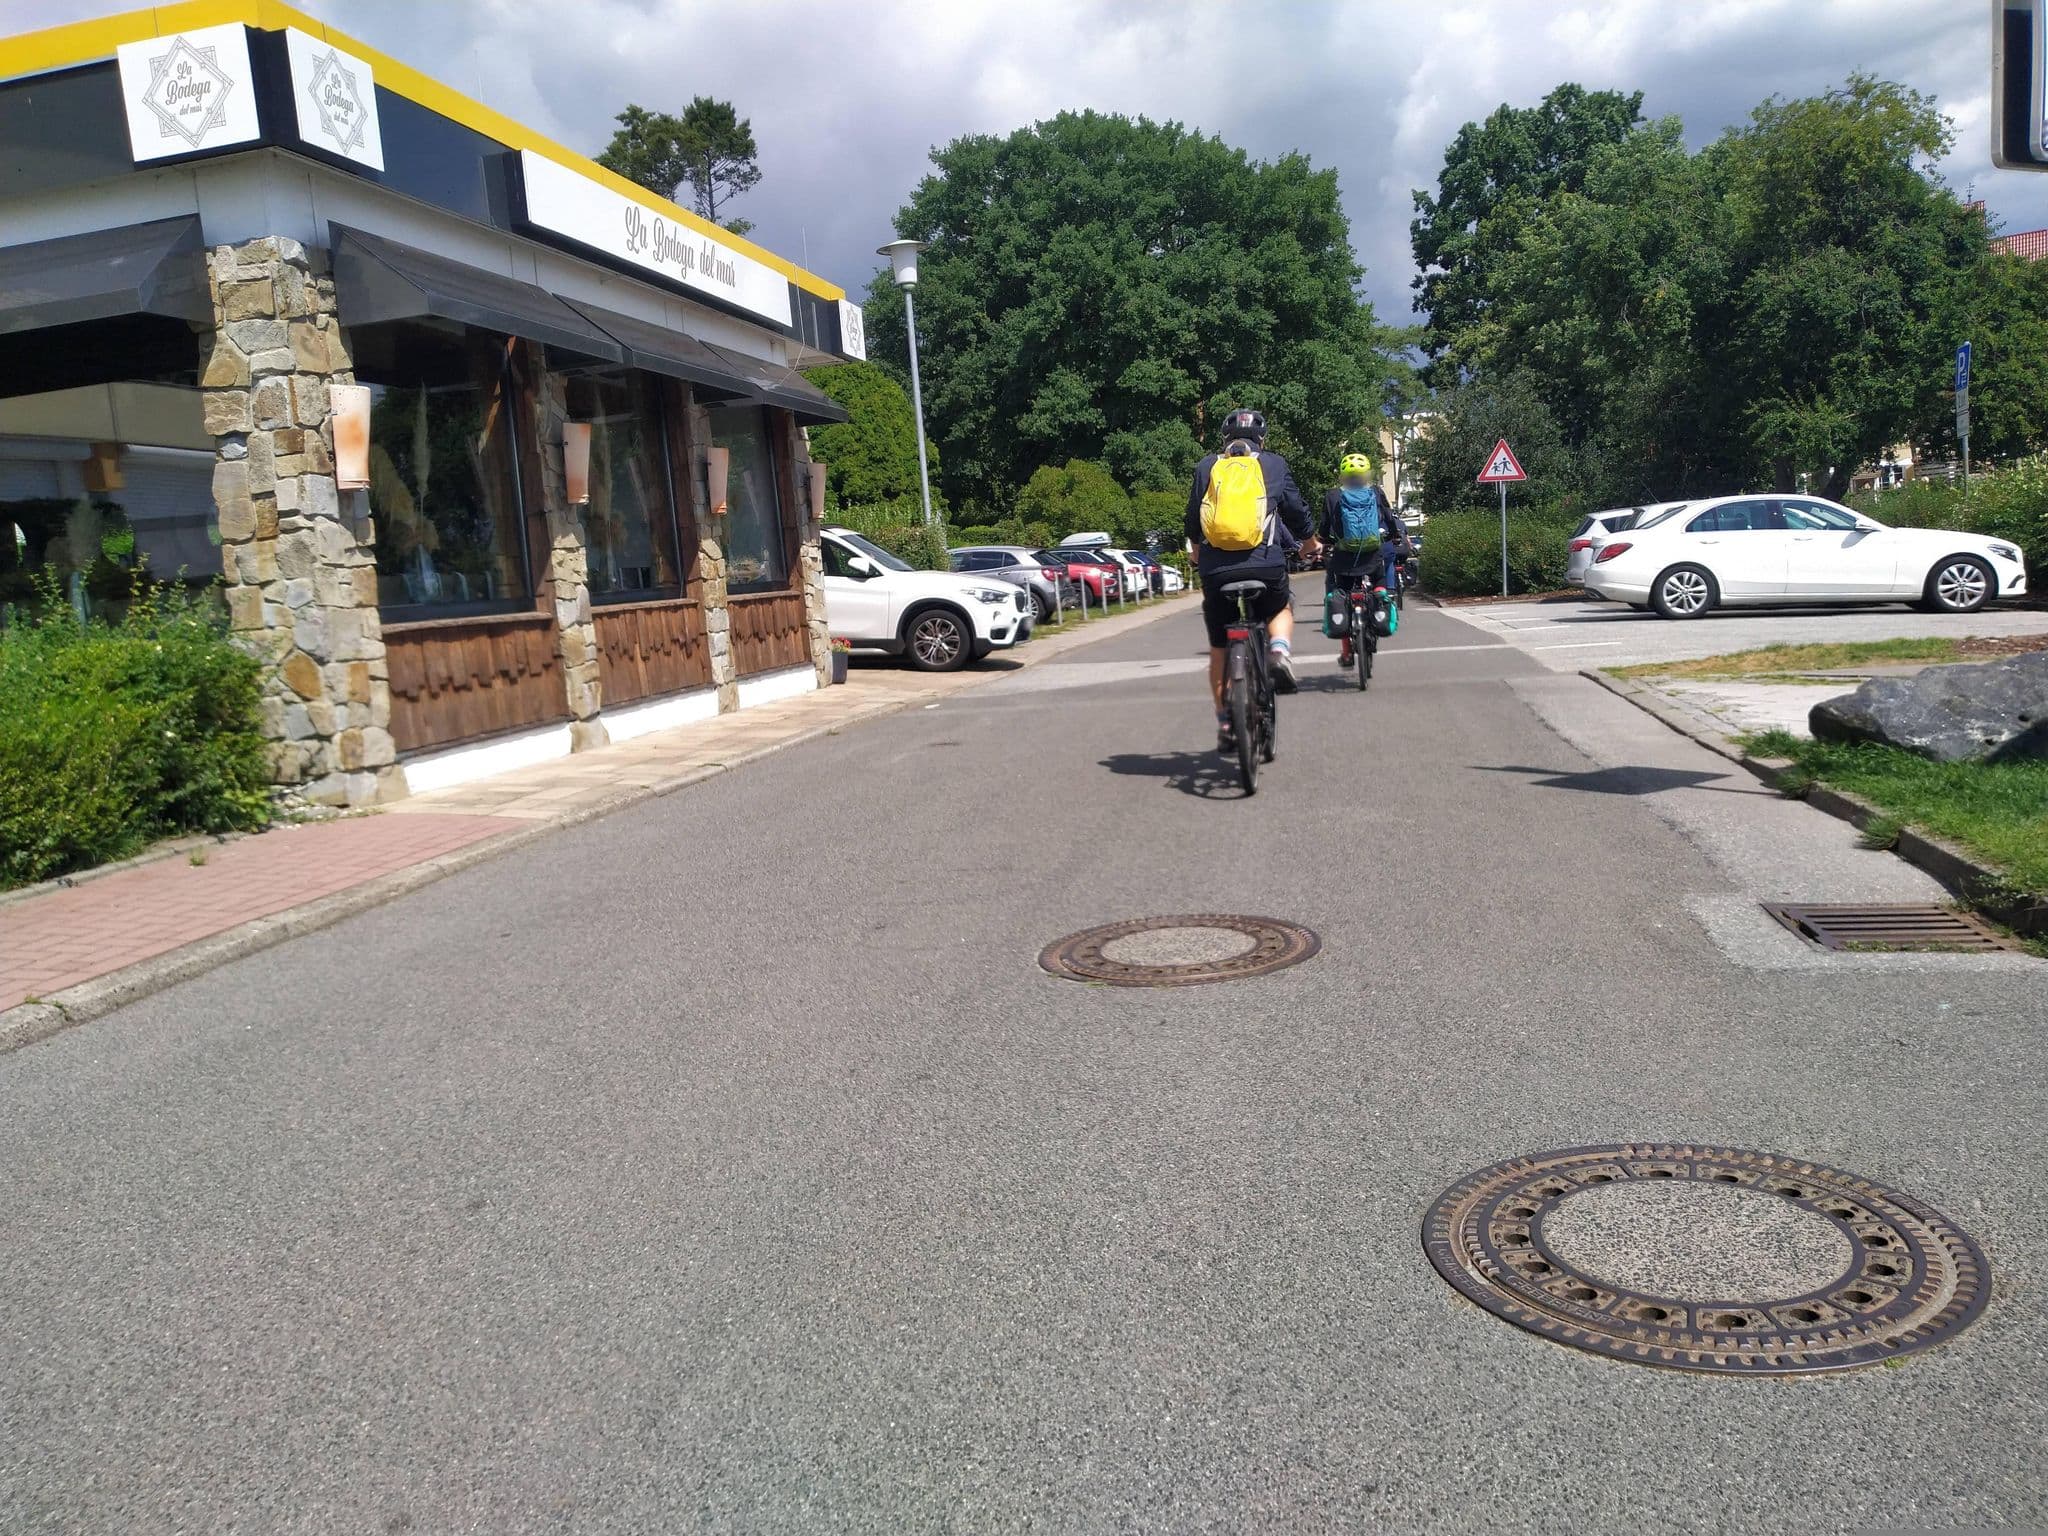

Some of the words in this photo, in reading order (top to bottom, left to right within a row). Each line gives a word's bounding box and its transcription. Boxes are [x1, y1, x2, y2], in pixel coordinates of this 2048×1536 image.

[177, 61, 192, 80] La
[331, 73, 341, 90] La
[165, 77, 211, 106] Bodega
[324, 84, 354, 117] Bodega
[625, 206, 648, 255] La
[653, 217, 695, 280] Bodega
[700, 240, 716, 279] del
[715, 259, 736, 288] mar
[1957, 351, 1966, 386] P
